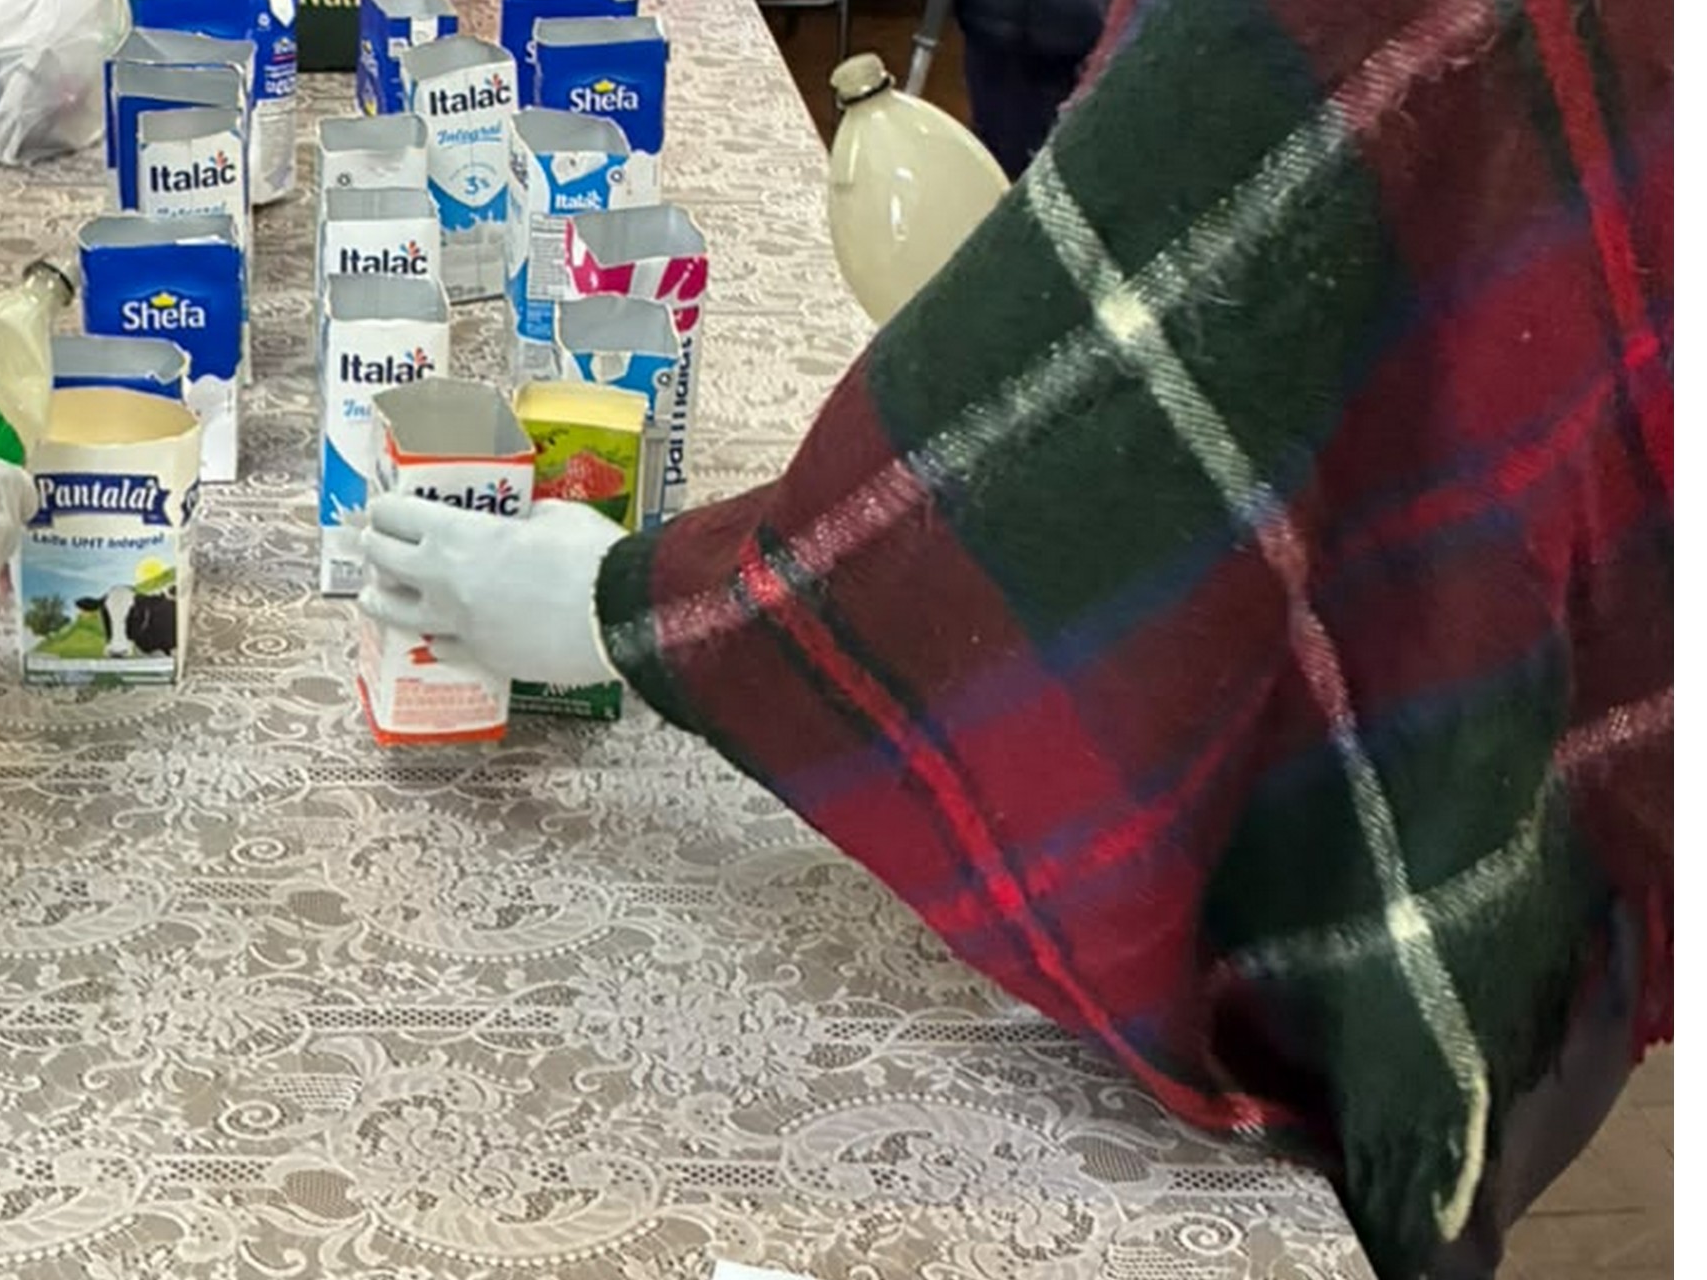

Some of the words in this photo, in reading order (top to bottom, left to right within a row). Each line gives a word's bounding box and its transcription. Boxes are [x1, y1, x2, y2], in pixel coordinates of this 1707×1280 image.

[429, 85, 511, 116] Italac
[569, 85, 639, 113] Shefa
[150, 162, 237, 192] Italac
[340, 247, 428, 275] Italac
[123, 299, 207, 331] Shefa
[340, 352, 435, 385] Italac
[37, 477, 158, 511] Pantalat
